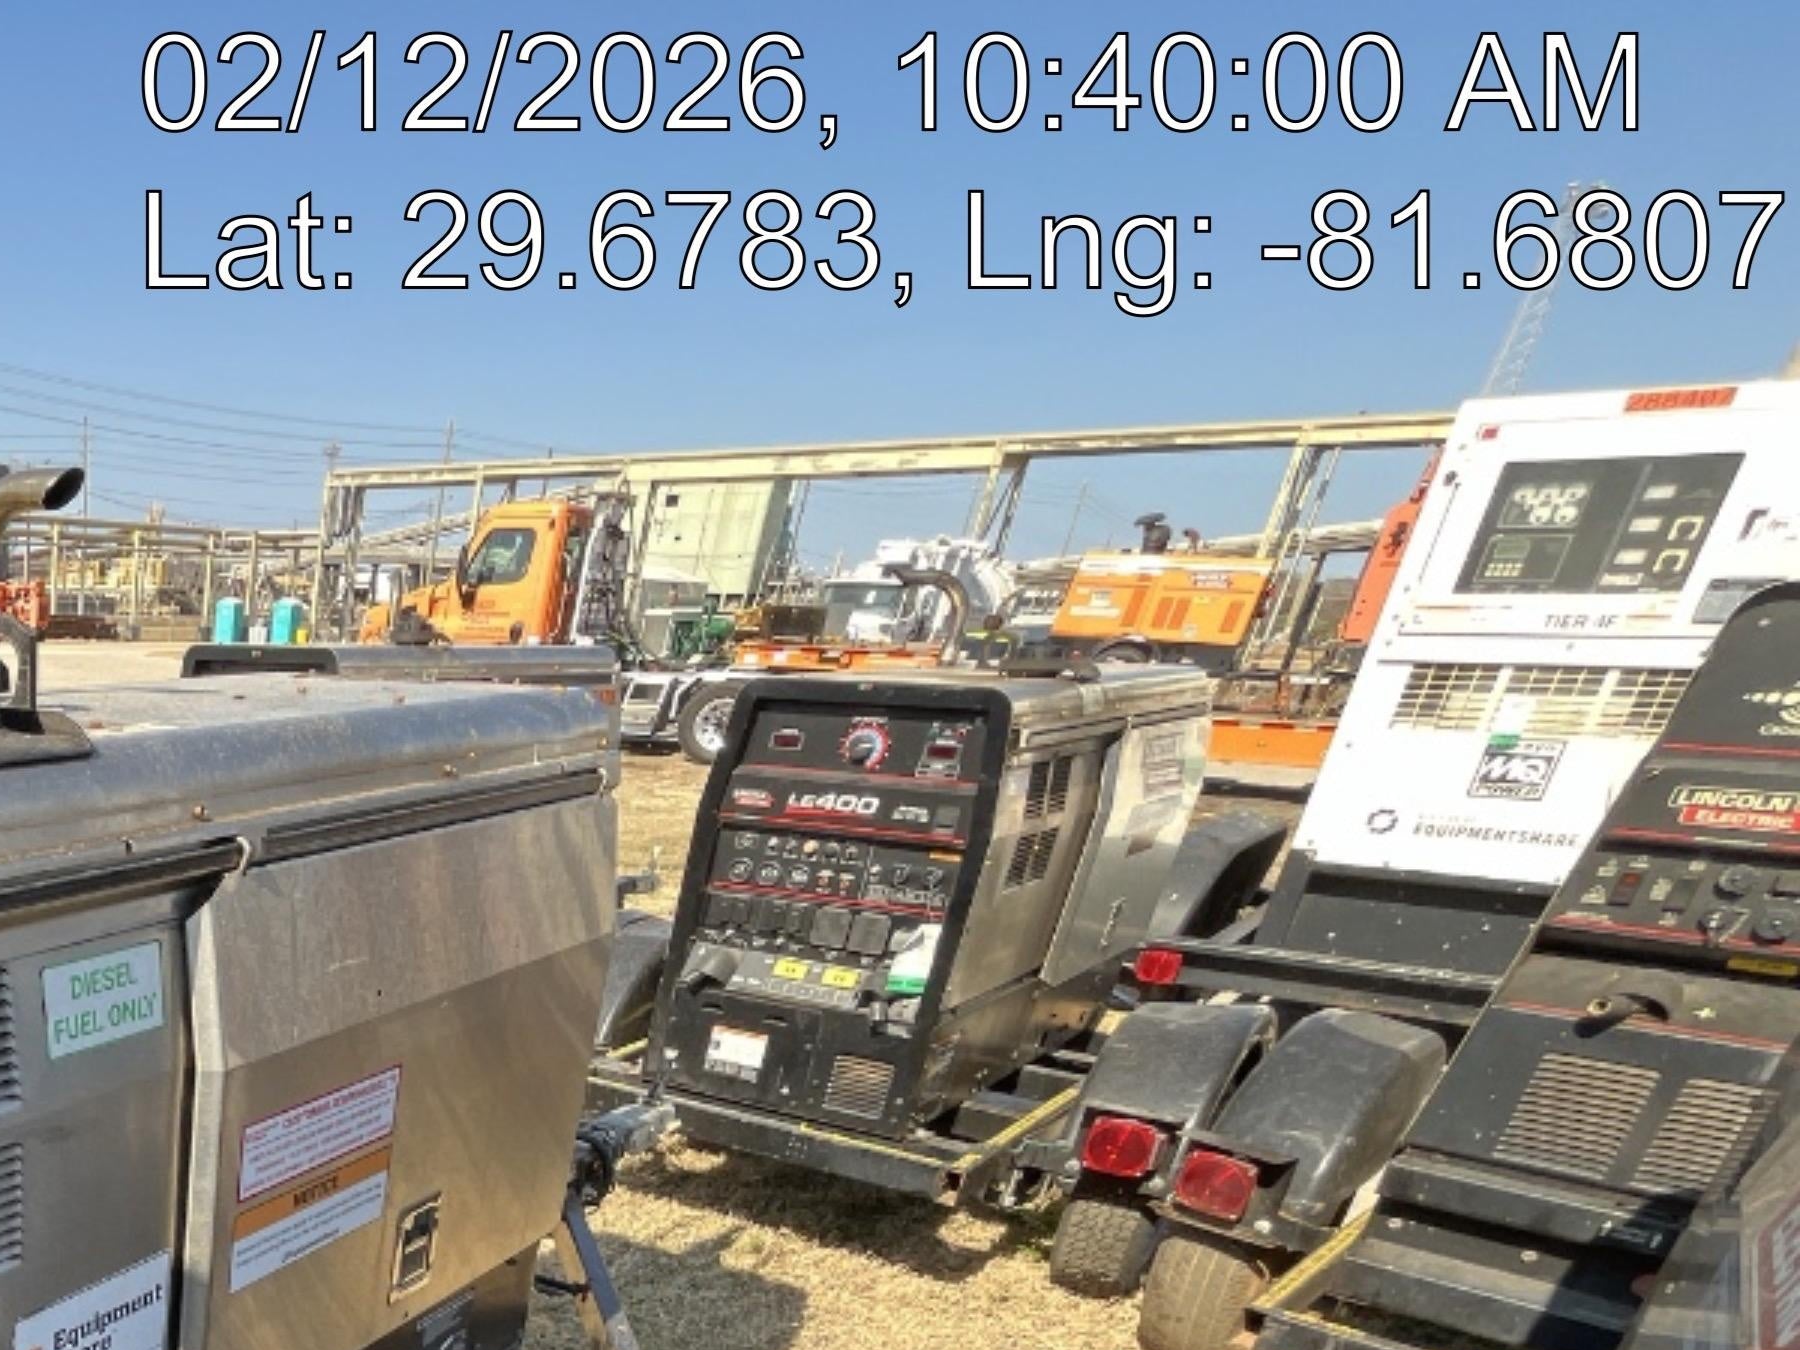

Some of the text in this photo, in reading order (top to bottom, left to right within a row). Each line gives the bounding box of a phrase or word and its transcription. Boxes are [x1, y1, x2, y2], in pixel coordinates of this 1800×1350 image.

[1678, 787, 1793, 812] LINCOLN
[1694, 808, 1794, 830] ELECTRIC
[1412, 822, 1580, 848] EQUIPMENTSHARE
[70, 962, 138, 1001] DIESEL
[53, 991, 157, 1045] FUEL ONLY
